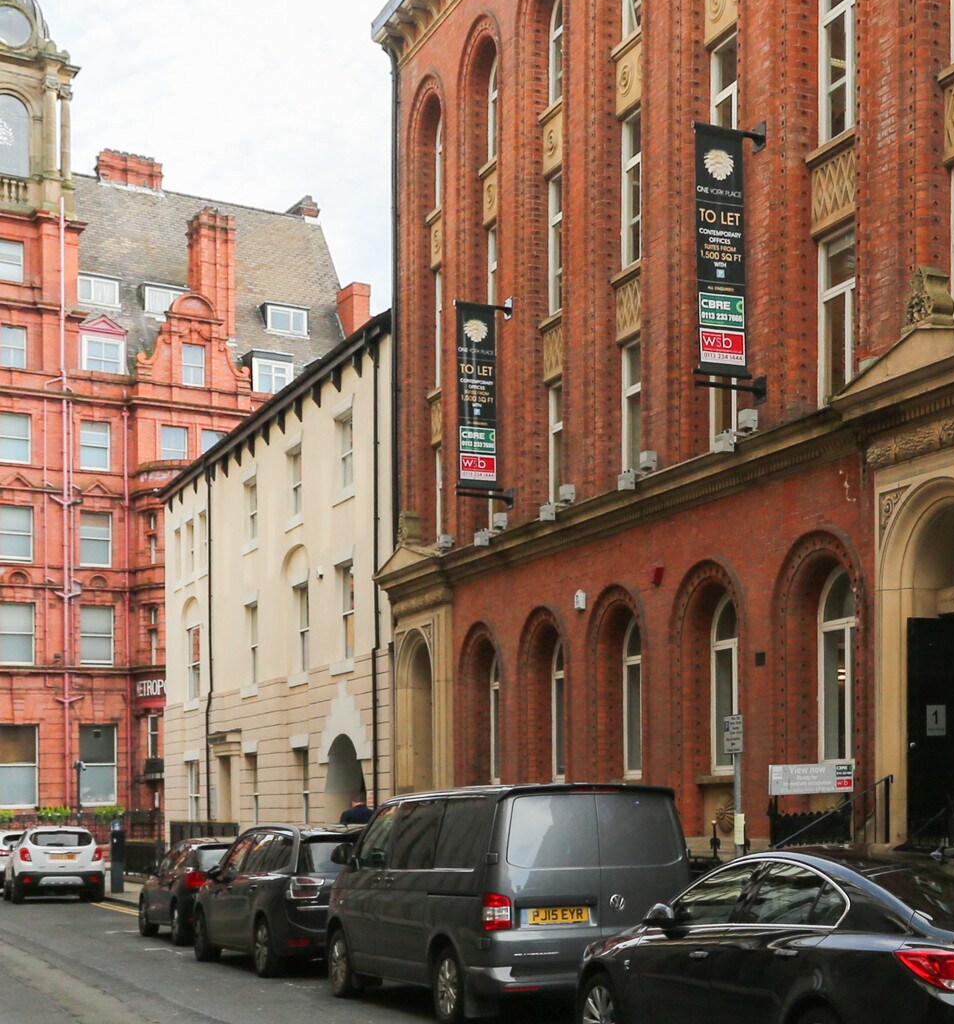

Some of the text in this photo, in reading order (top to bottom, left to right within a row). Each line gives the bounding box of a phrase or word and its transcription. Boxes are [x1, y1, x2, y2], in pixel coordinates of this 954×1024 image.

[696, 185, 709, 194] ONE
[725, 190, 742, 198] PLACE
[699, 208, 741, 226] TO LET
[699, 227, 741, 238] CONTEMPORARY
[709, 236, 731, 245] OFFICES
[721, 252, 732, 261] SQ
[733, 254, 742, 262] FT
[701, 298, 731, 311] CBRE
[701, 311, 715, 320] 0113
[702, 332, 733, 349] wsb
[460, 363, 493, 376] TO LET
[461, 431, 485, 440] CBRE
[462, 456, 486, 469] wsb
[932, 709, 938, 725] 1
[789, 766, 808, 774] View
[532, 908, 583, 921] PJ15 EYR
